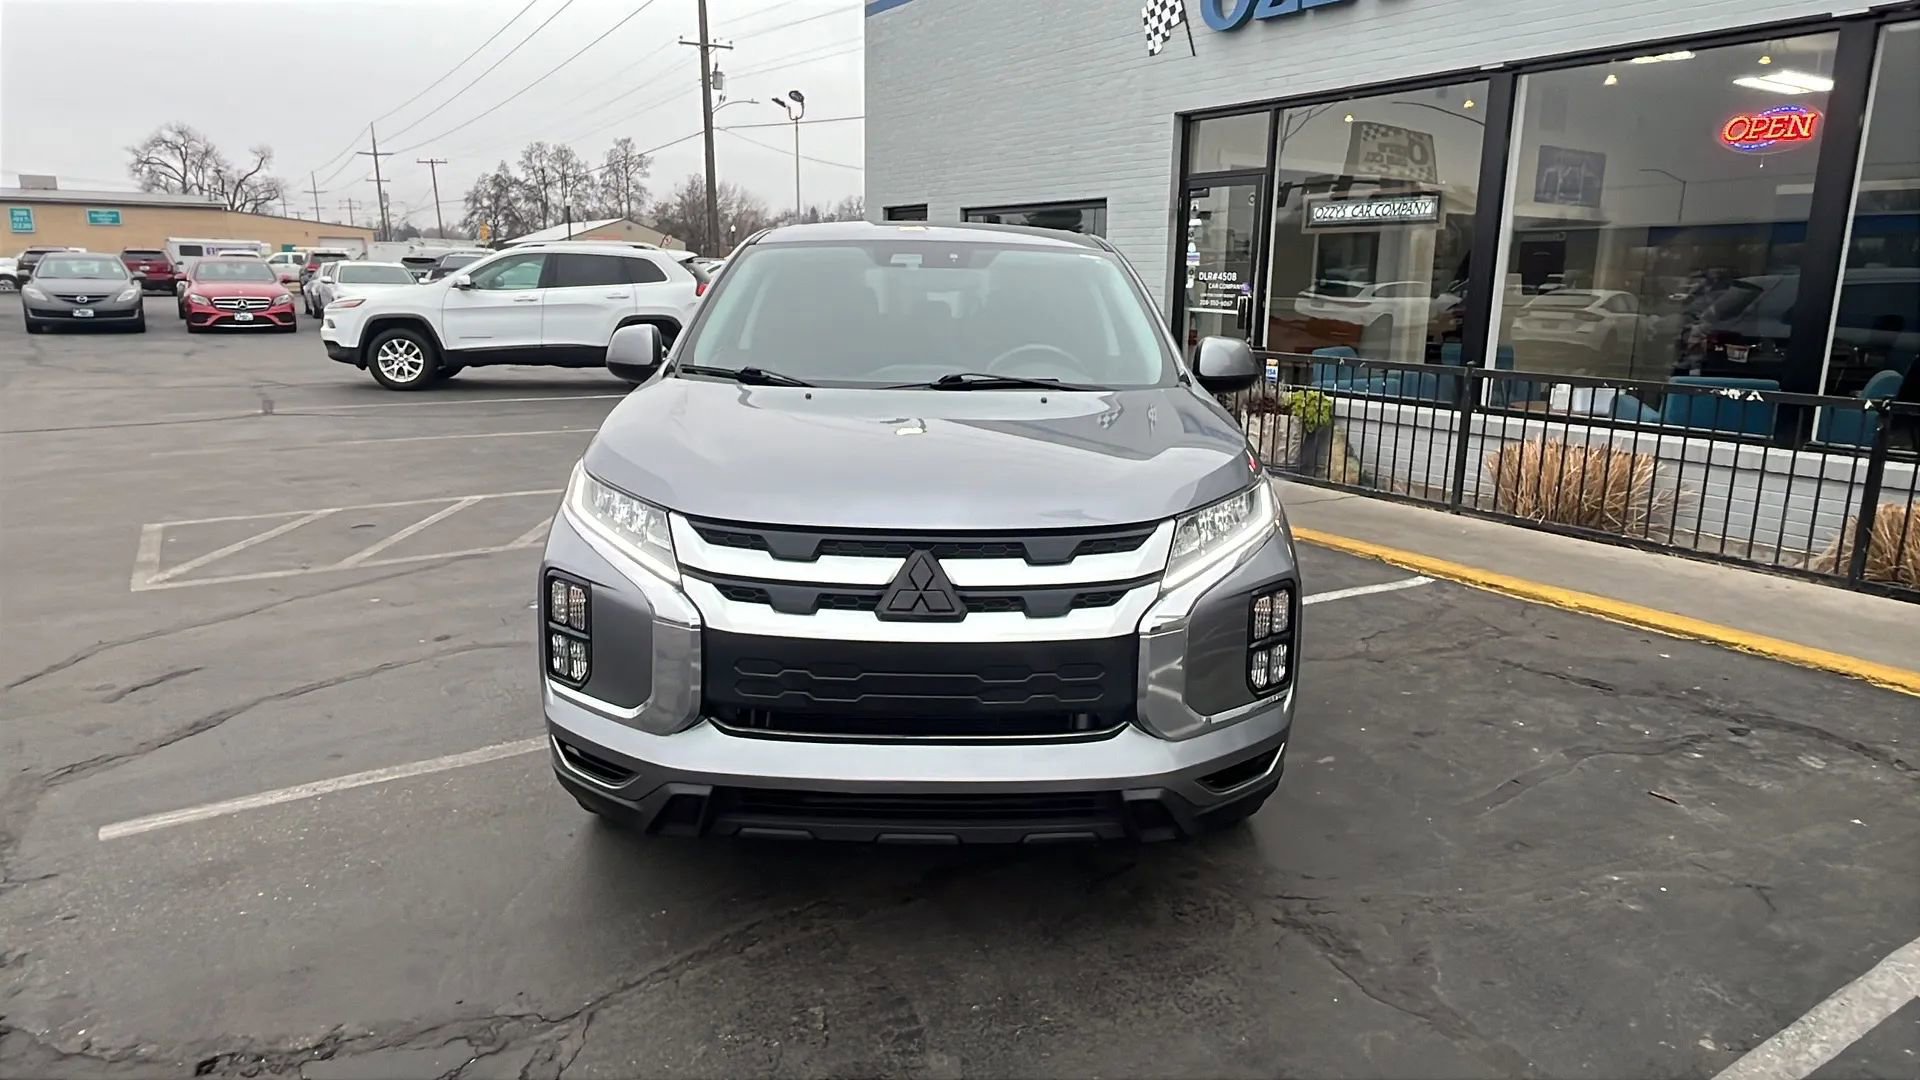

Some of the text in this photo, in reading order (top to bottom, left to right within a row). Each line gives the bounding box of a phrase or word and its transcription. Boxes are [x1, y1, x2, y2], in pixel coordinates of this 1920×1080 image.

[1722, 112, 1816, 141] OPEN
[1351, 205, 1371, 217] CAR
[1375, 202, 1431, 217] COMPANY
